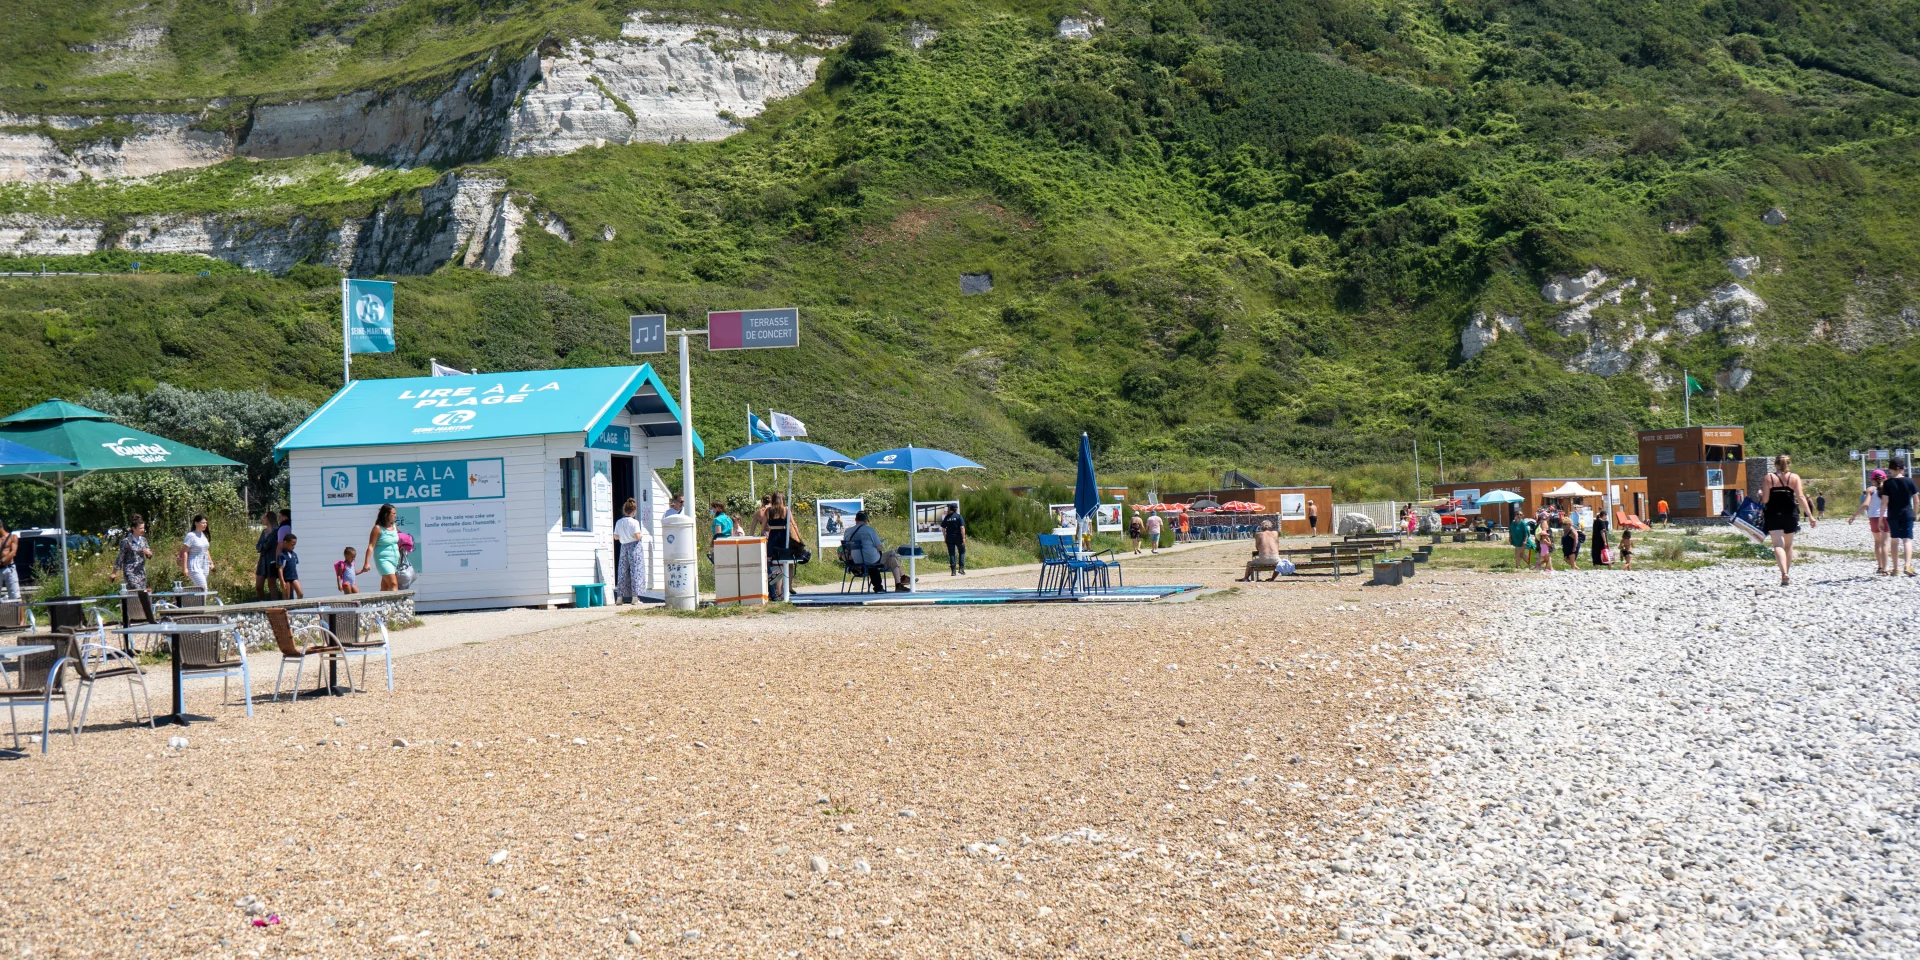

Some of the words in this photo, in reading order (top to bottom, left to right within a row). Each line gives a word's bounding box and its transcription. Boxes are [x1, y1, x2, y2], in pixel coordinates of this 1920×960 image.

[750, 317, 789, 327] TERRASSE
[746, 331, 756, 340] DE
[757, 329, 793, 339] CONCERT
[397, 386, 476, 400] LIRE
[482, 383, 504, 395] À
[518, 382, 560, 393] LA
[413, 394, 528, 409] PLAGE
[600, 432, 618, 444] PLAGE
[102, 437, 171, 456] Tourtel
[369, 469, 407, 484] LIRE
[414, 465, 426, 481] À
[433, 467, 455, 480] LA
[384, 484, 442, 500] PLAGE
